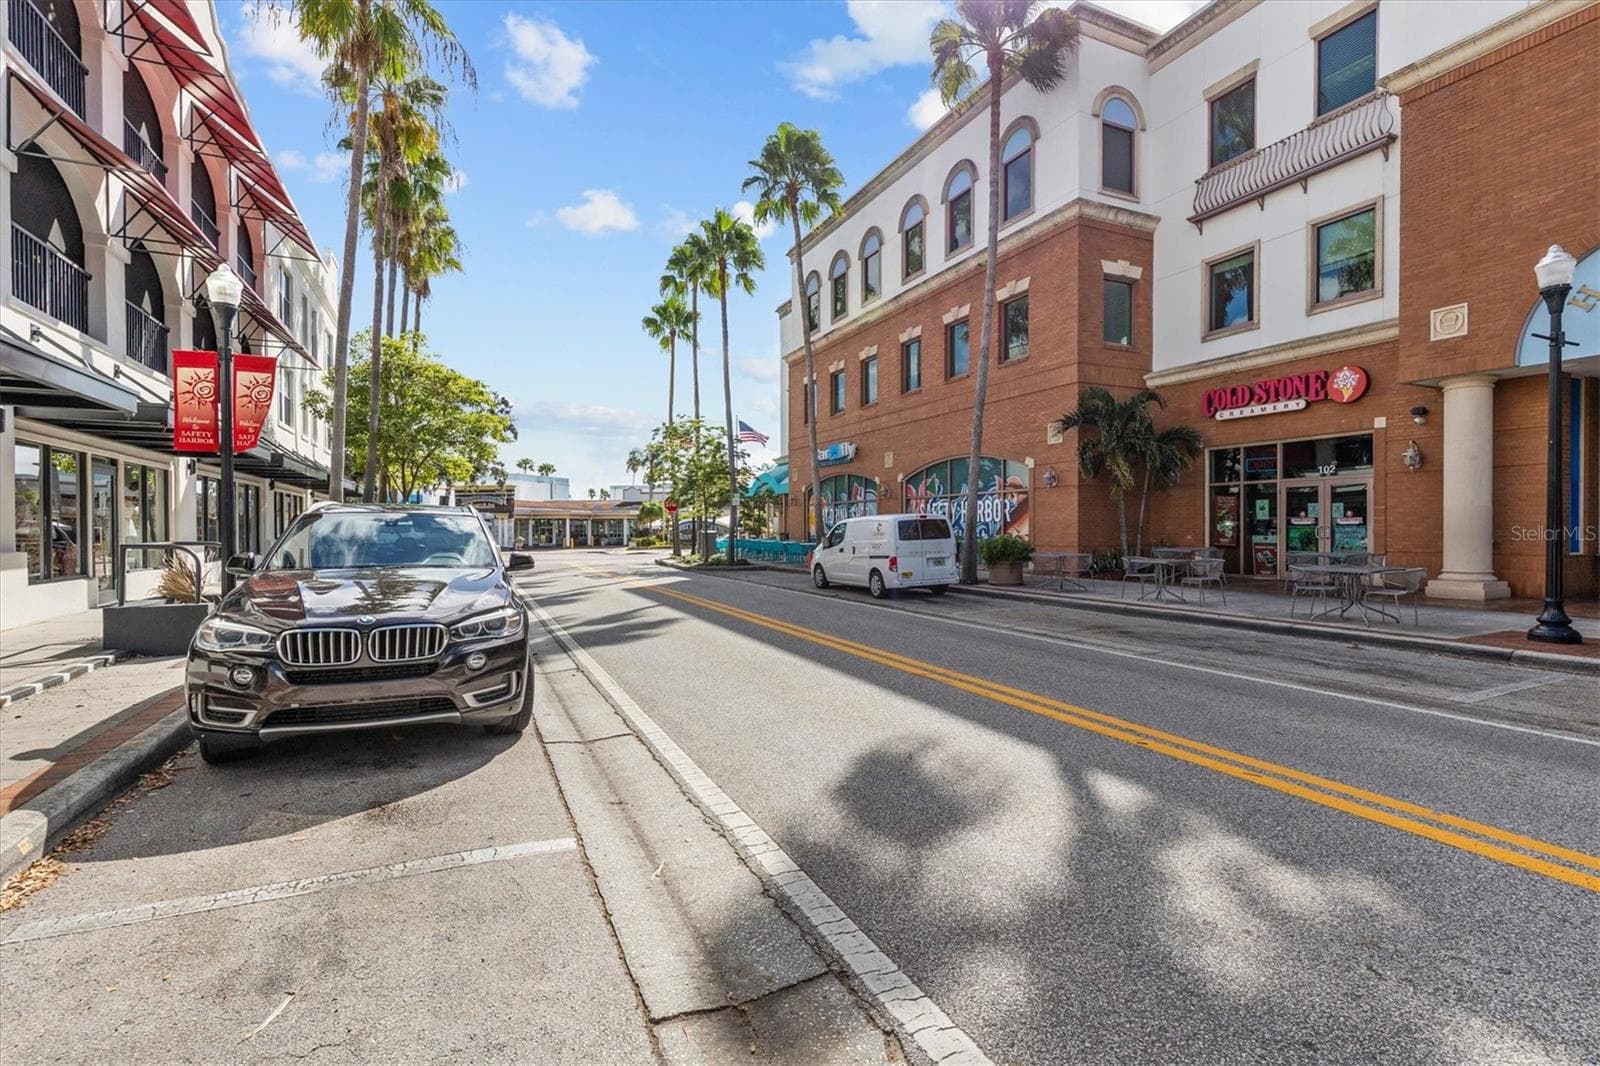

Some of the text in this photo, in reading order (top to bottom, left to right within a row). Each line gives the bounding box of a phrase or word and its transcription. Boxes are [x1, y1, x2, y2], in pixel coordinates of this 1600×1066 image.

[1201, 370, 1328, 418] COLD STONE
[1218, 401, 1302, 419] CREAMERY
[181, 430, 212, 438] SAFETY
[1318, 464, 1336, 474] 102
[961, 499, 1011, 523] HRBOR
